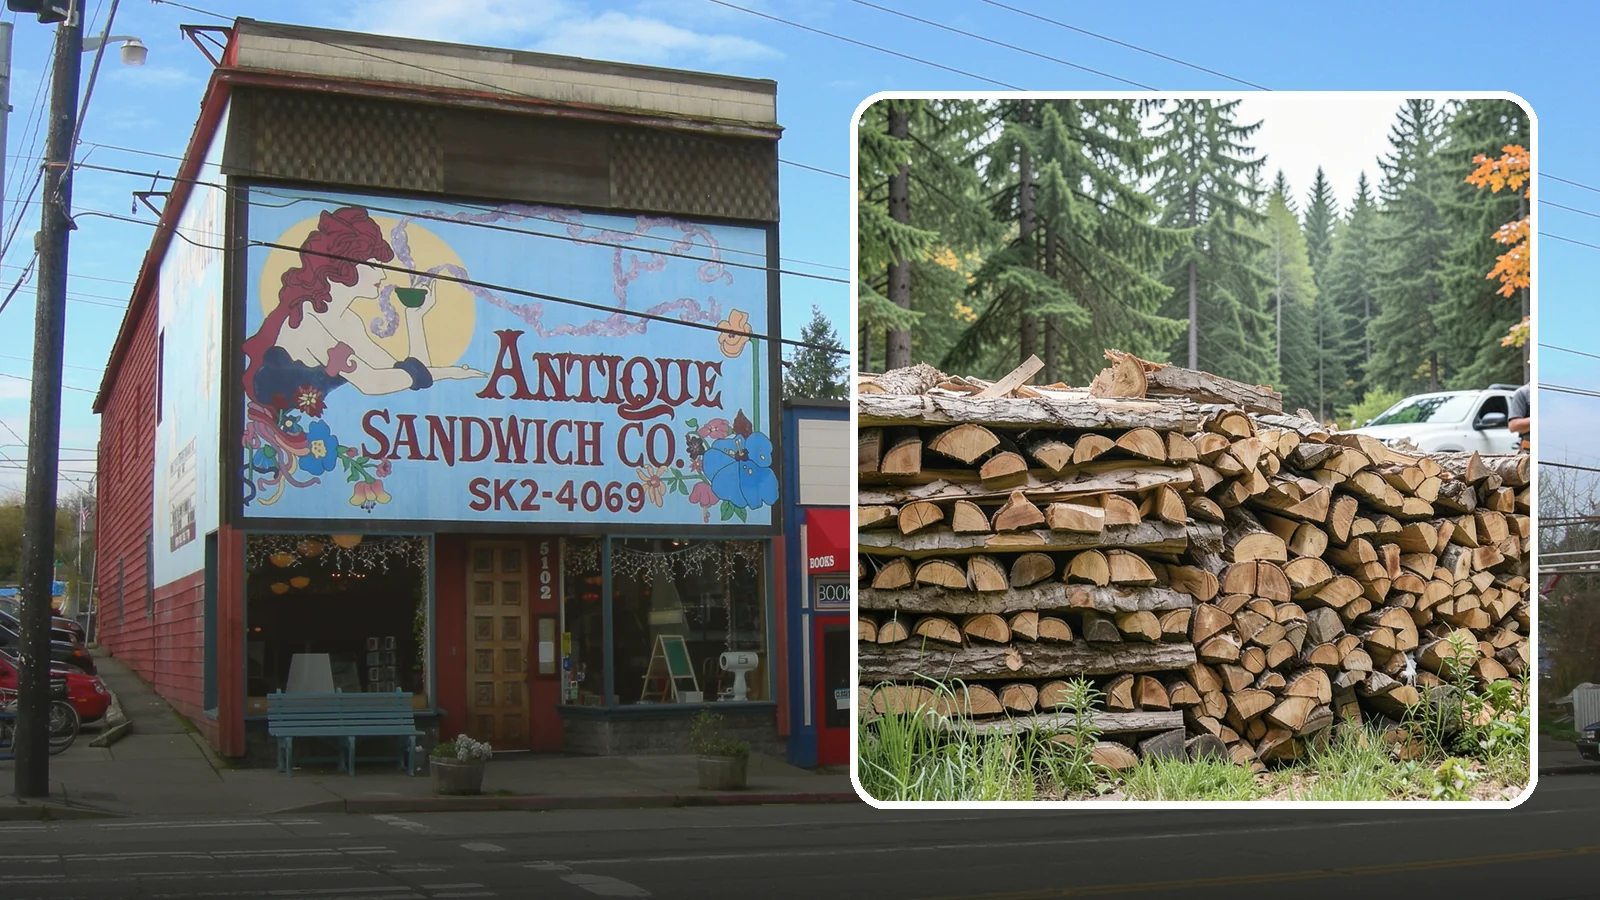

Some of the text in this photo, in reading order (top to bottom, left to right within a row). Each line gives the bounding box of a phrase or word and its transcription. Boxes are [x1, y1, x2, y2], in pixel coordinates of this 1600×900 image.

[475, 329, 724, 421] ANTIQUE
[361, 408, 685, 469] SANDWICH CO.
[468, 477, 646, 513] SK2-4069
[540, 542, 552, 599] 5102
[809, 555, 835, 569] BOOKS
